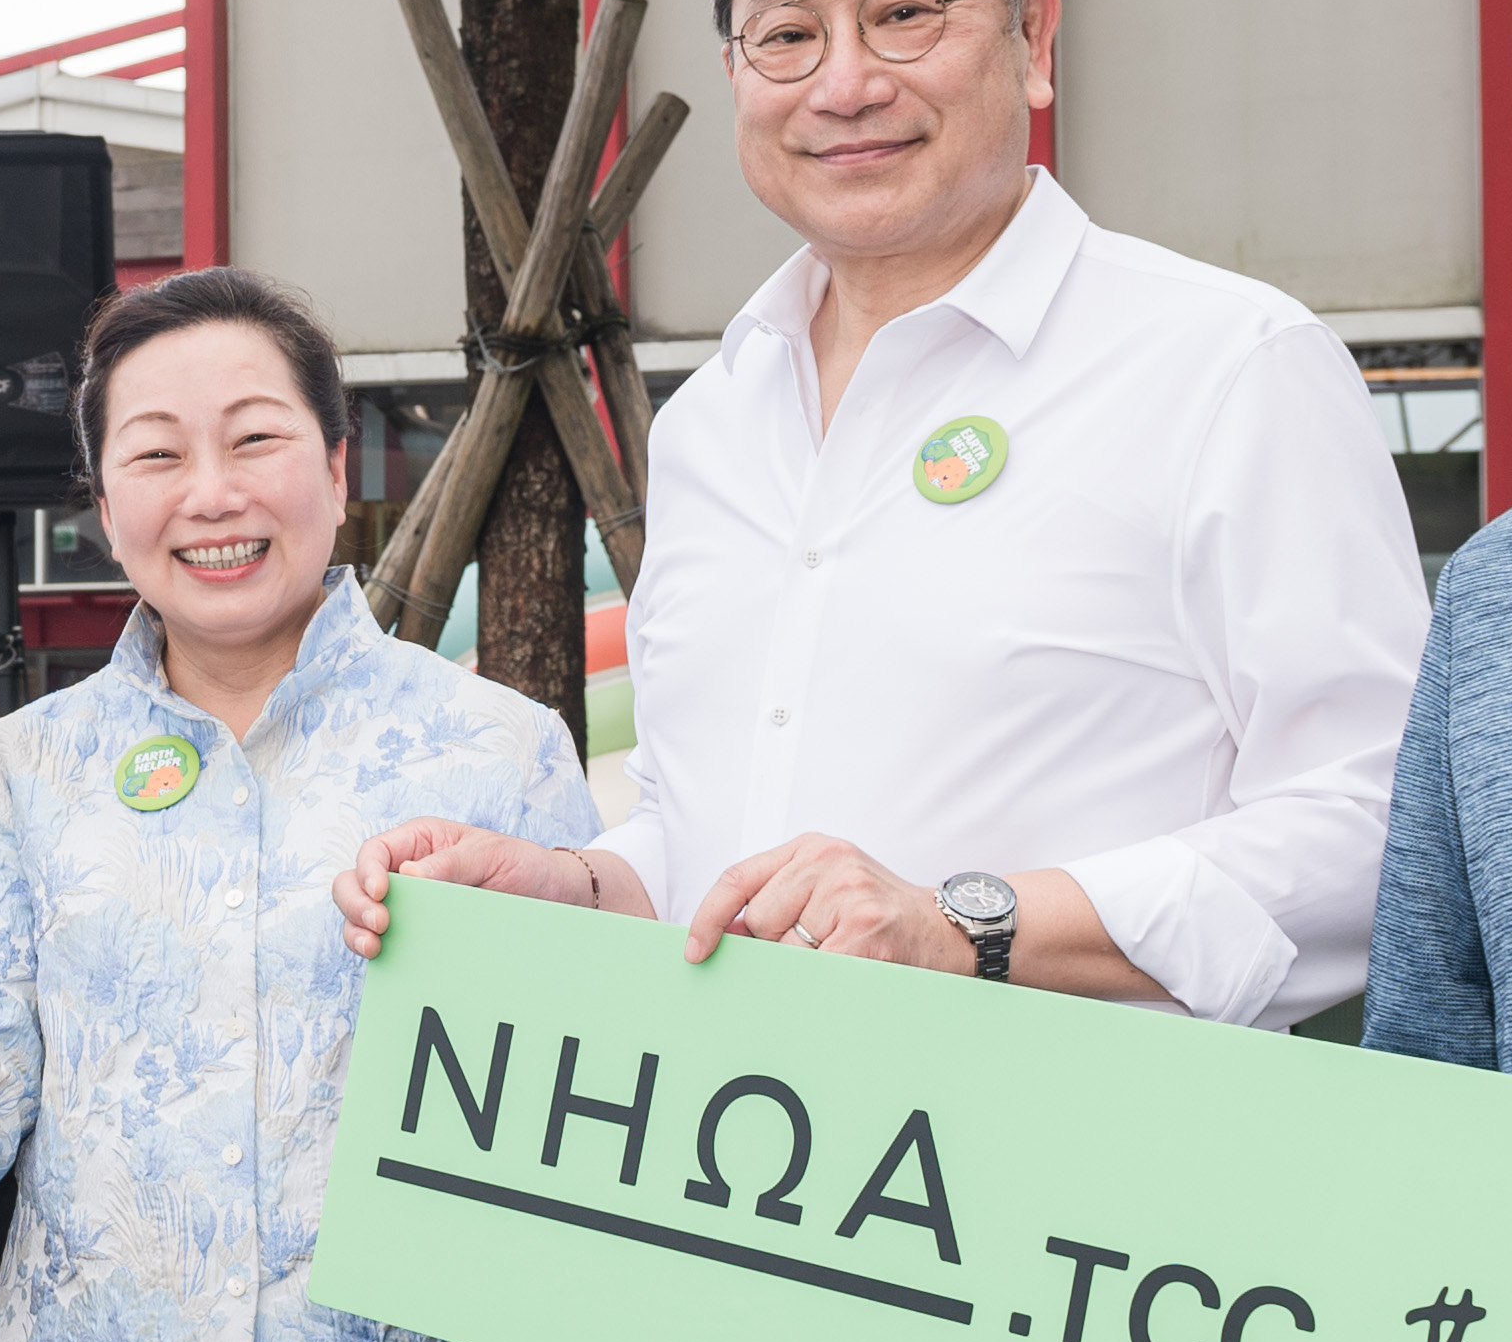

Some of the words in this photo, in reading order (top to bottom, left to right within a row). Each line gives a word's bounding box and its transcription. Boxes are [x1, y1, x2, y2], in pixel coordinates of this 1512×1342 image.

[948, 435, 981, 475] HELPER
[960, 427, 989, 461] EARTH
[134, 748, 174, 764] EARTH
[134, 756, 181, 774] HELPER
